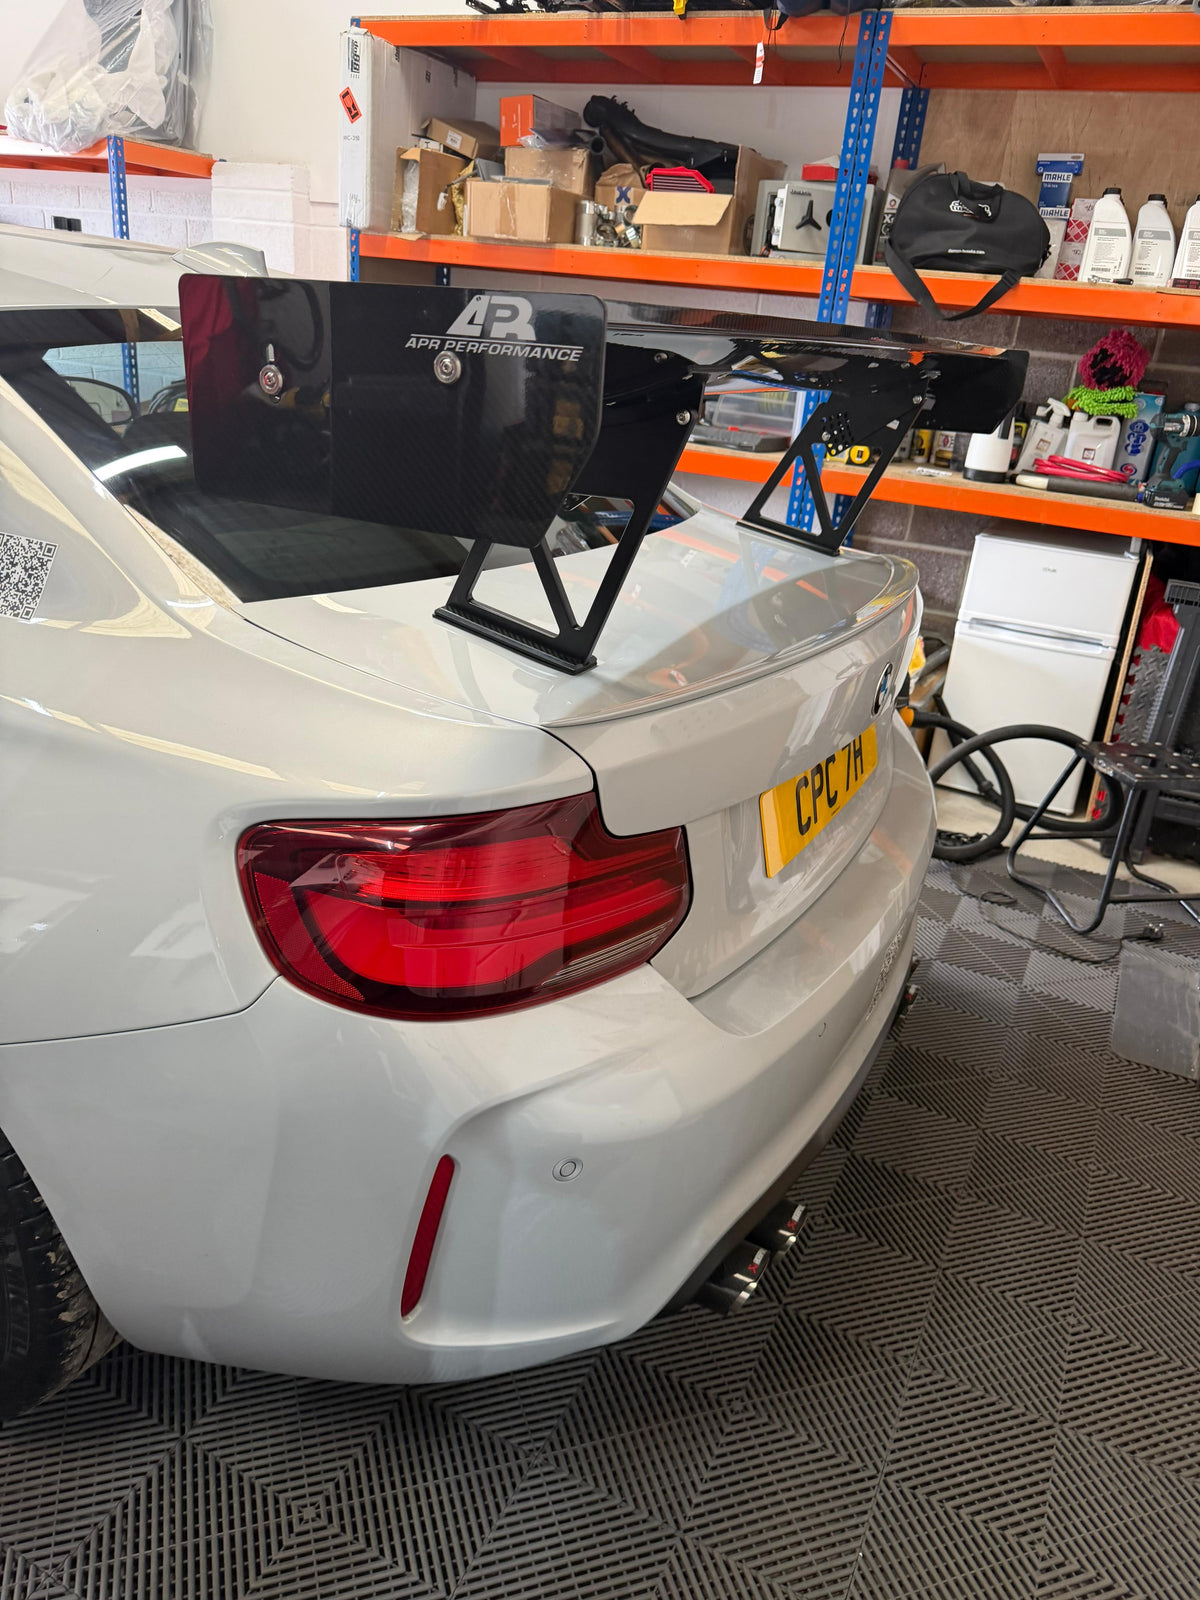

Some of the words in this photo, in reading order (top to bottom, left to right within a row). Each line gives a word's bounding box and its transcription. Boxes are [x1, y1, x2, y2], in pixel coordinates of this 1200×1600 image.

[1043, 173, 1072, 181] MAHLE
[1040, 209, 1069, 217] MAHLE
[405, 337, 441, 350] APR
[443, 340, 583, 362] PERFORMANCE
[795, 753, 838, 836] CPC
[841, 734, 864, 792] 7H
